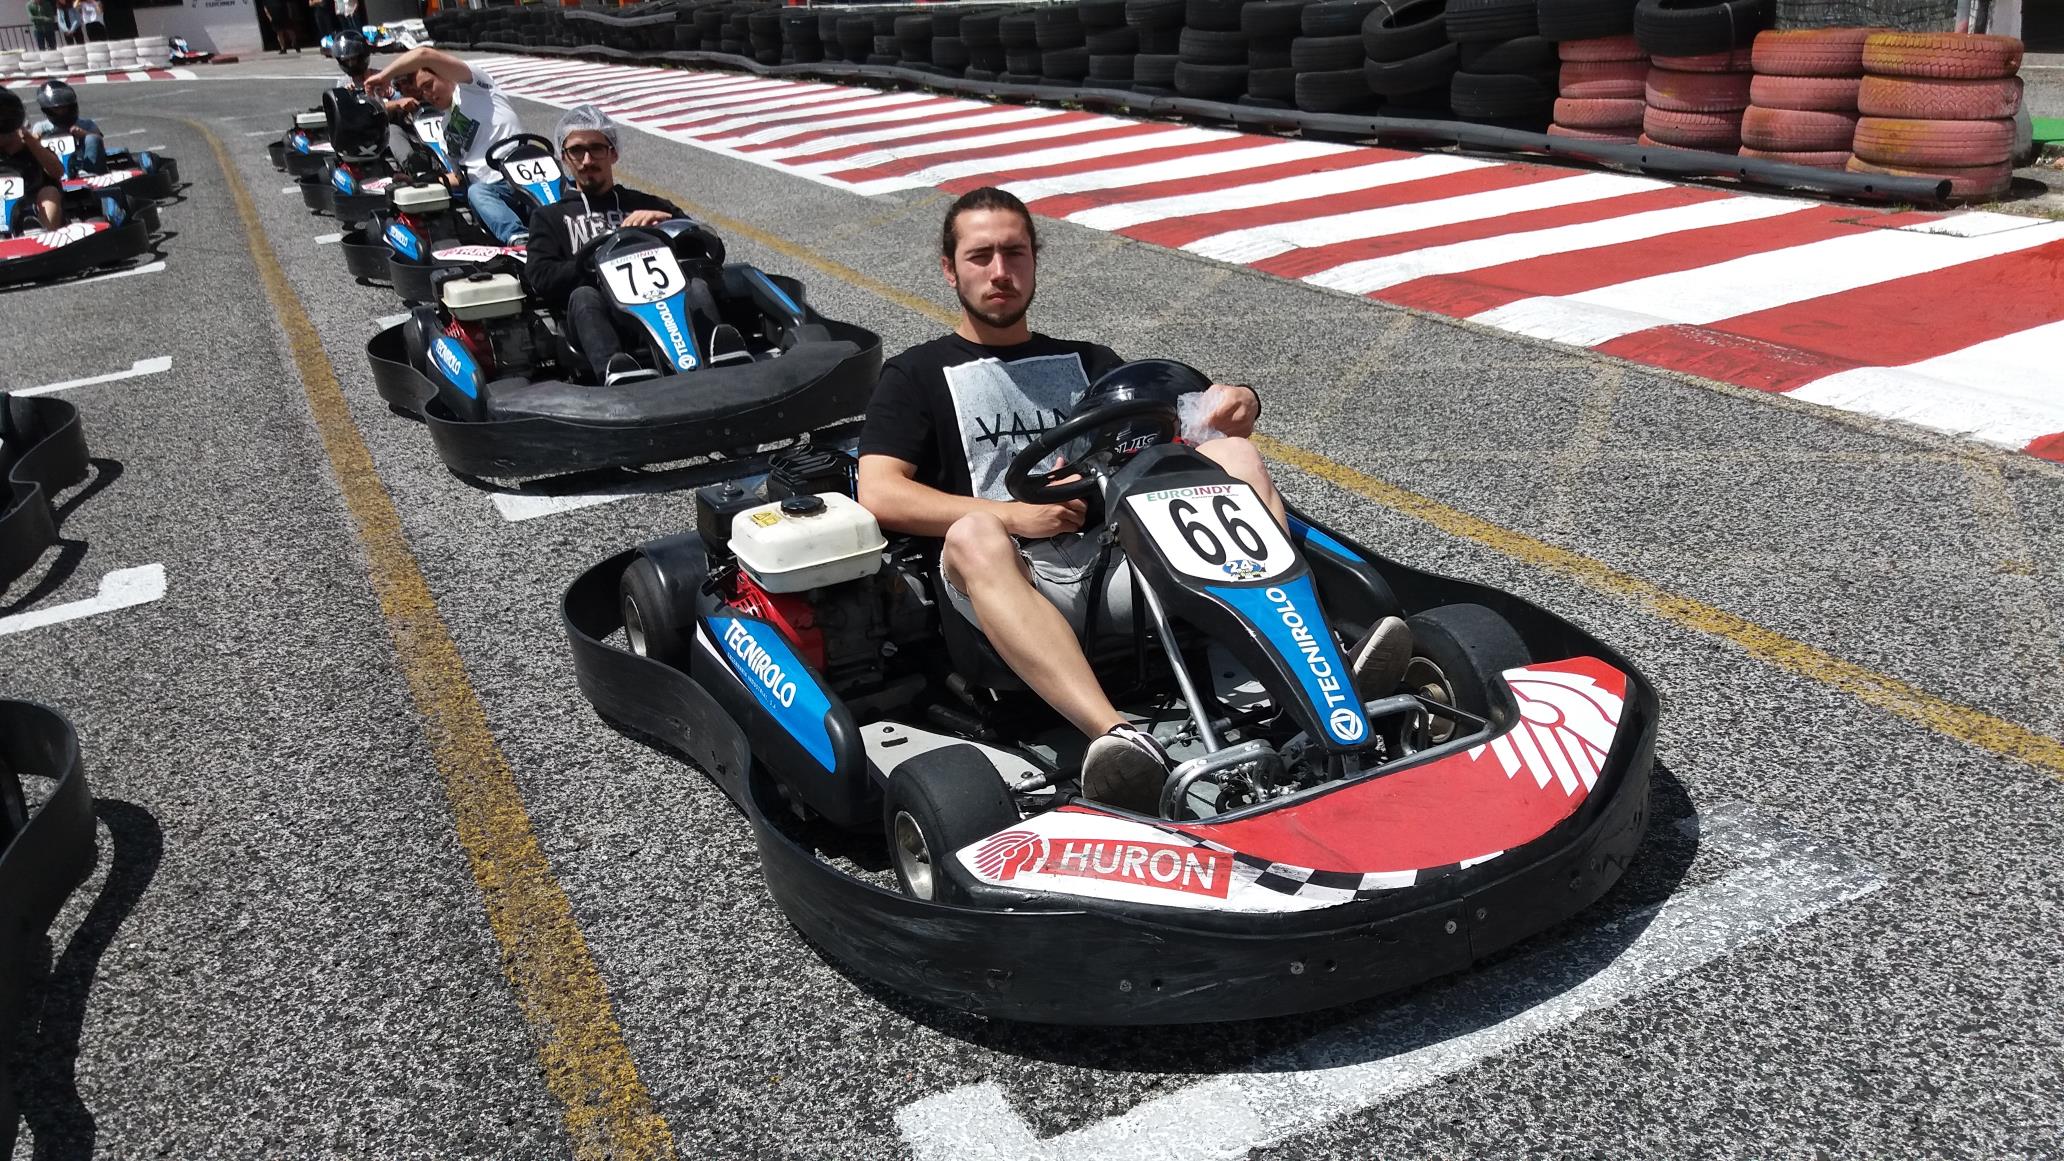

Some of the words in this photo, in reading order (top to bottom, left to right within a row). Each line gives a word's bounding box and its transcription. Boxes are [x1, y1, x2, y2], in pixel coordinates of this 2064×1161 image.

[516, 161, 547, 181] 64
[615, 256, 670, 296] 75
[655, 301, 689, 358] TECNIROLO
[1146, 485, 1232, 502] EUROINDY
[1168, 495, 1269, 566] 66
[723, 618, 797, 708] TECNIROLO
[1265, 587, 1345, 708] TECNIROLO
[1060, 841, 1217, 891] HURON
